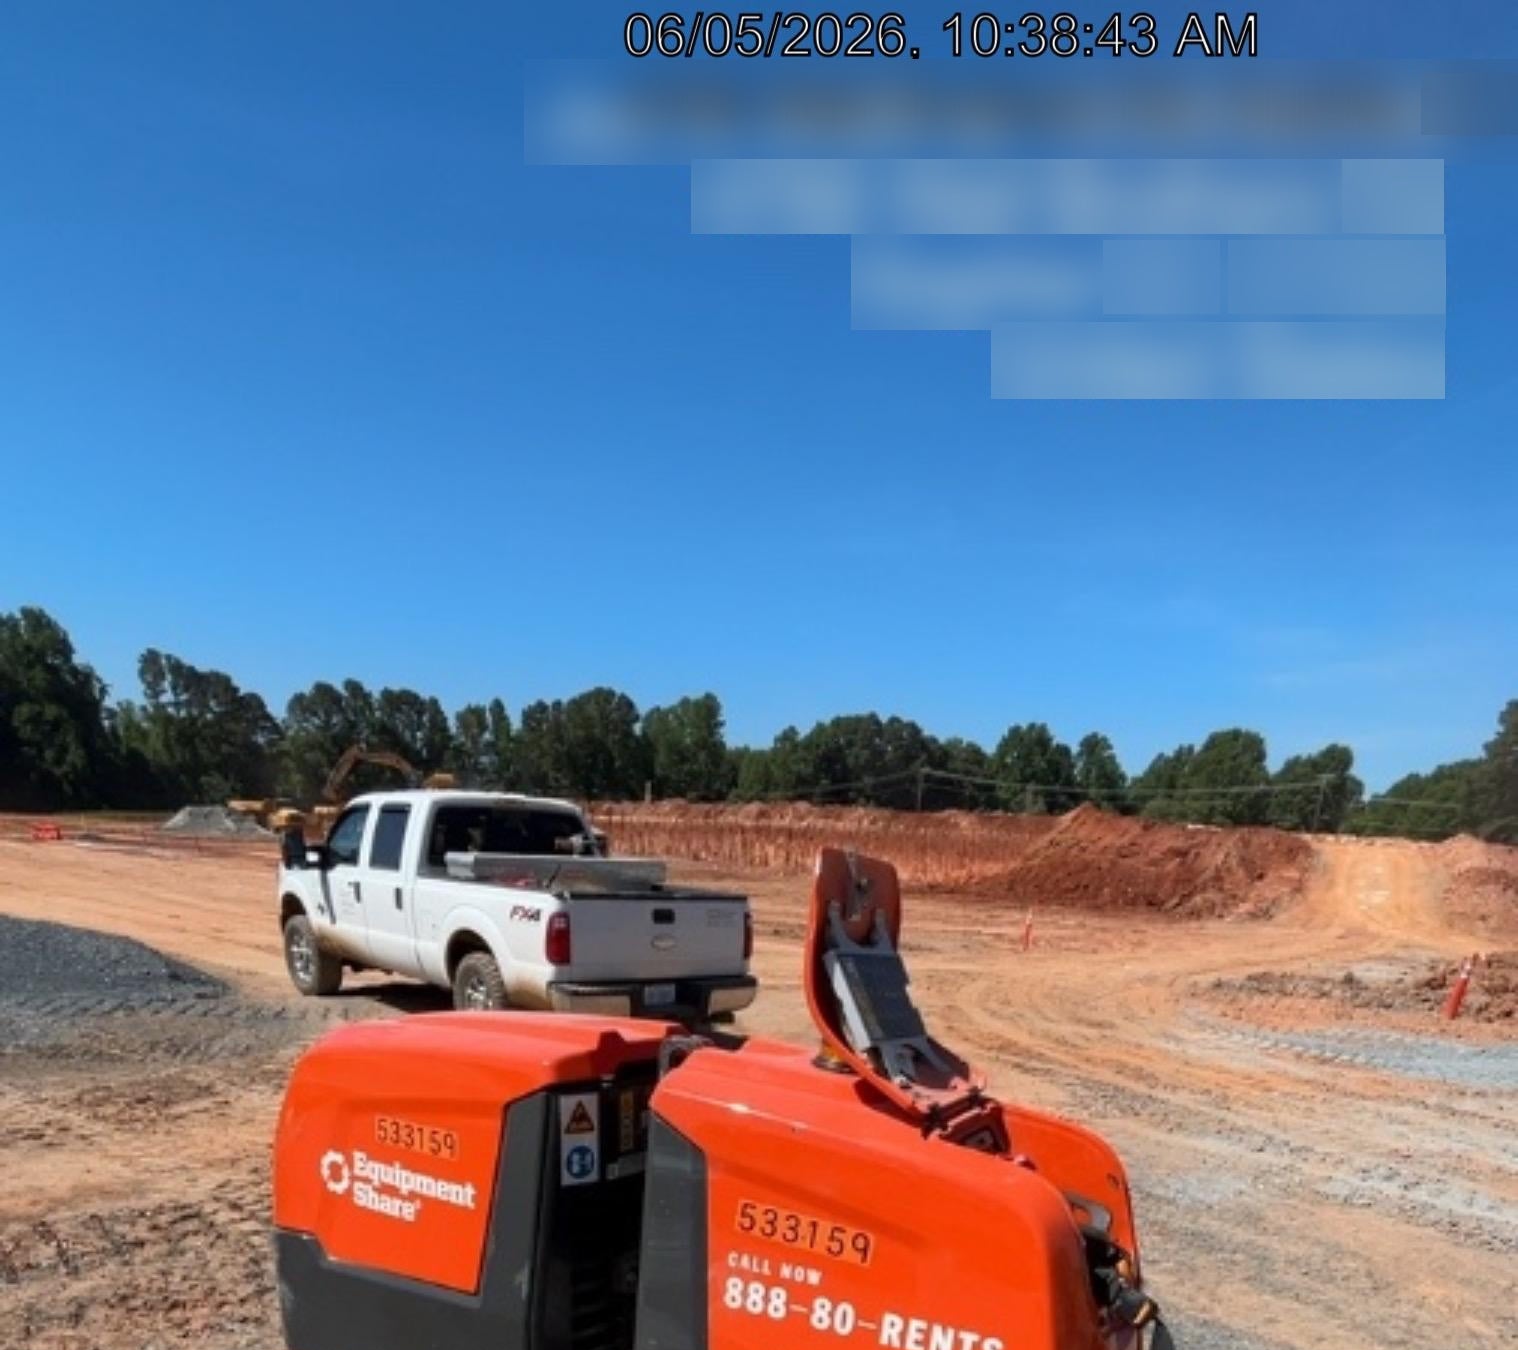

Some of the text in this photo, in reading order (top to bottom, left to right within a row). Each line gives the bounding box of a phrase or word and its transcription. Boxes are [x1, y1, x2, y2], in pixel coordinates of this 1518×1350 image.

[377, 1118, 457, 1157] 533159
[352, 1150, 477, 1209] Equipment
[738, 1202, 871, 1264] 533159
[727, 1251, 823, 1286] CALL NOW
